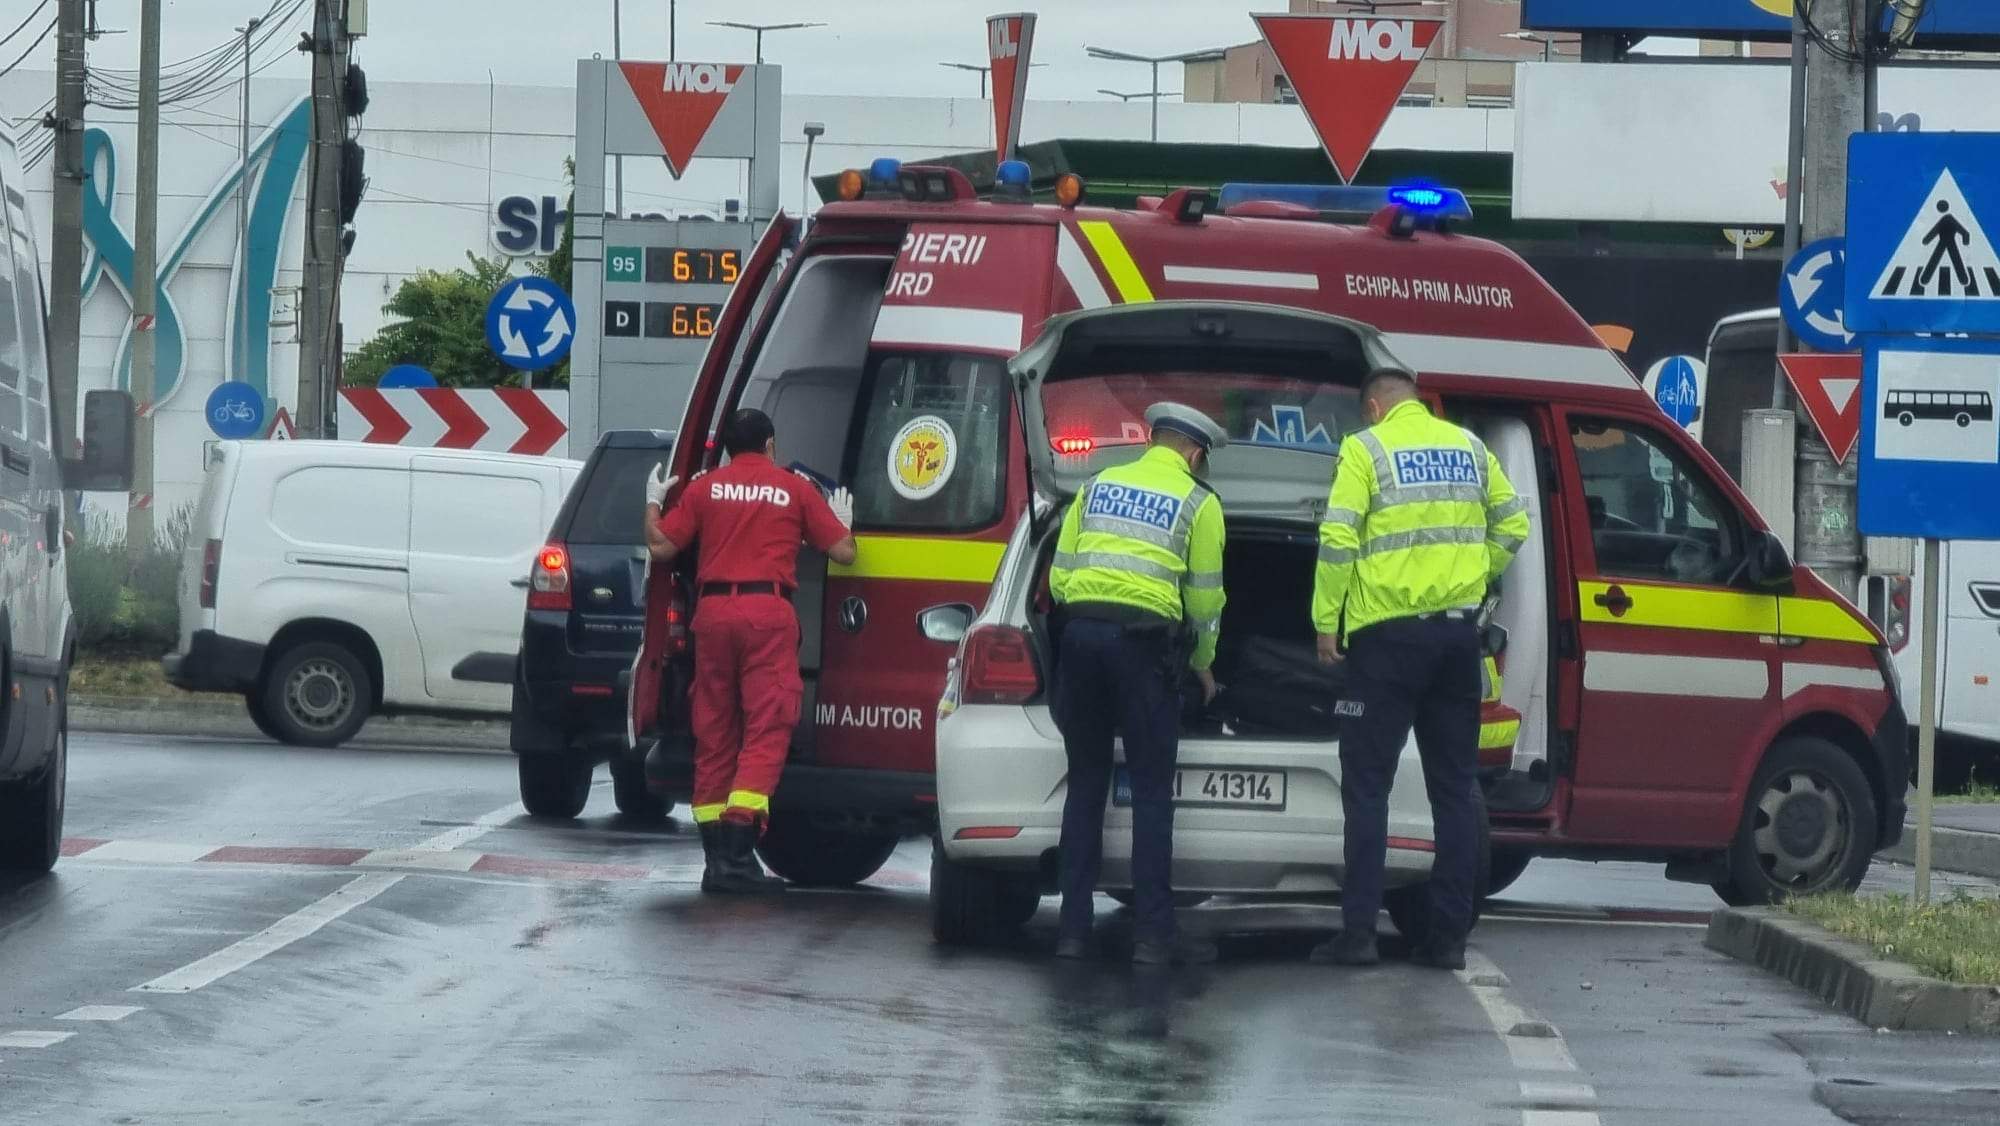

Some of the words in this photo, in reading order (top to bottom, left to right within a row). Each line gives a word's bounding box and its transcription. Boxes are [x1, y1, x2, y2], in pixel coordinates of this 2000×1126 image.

[1328, 19, 1428, 61] MOL
[663, 63, 735, 93] MOL
[613, 256, 635, 273] 95
[673, 251, 738, 283] 6.75
[1345, 273, 1409, 299] ECHIPAJ
[1413, 278, 1451, 303] PRIM
[1454, 283, 1514, 309] AJUTOR
[616, 311, 629, 327] D
[1397, 451, 1473, 468] POLITIA
[1401, 466, 1477, 483] RUTIERA
[710, 483, 790, 507] SMURD
[1095, 484, 1174, 513] POLITIA
[1091, 498, 1170, 528] RUTIERA
[840, 704, 922, 730] AJUTOR
[1202, 771, 1272, 801] 41314
